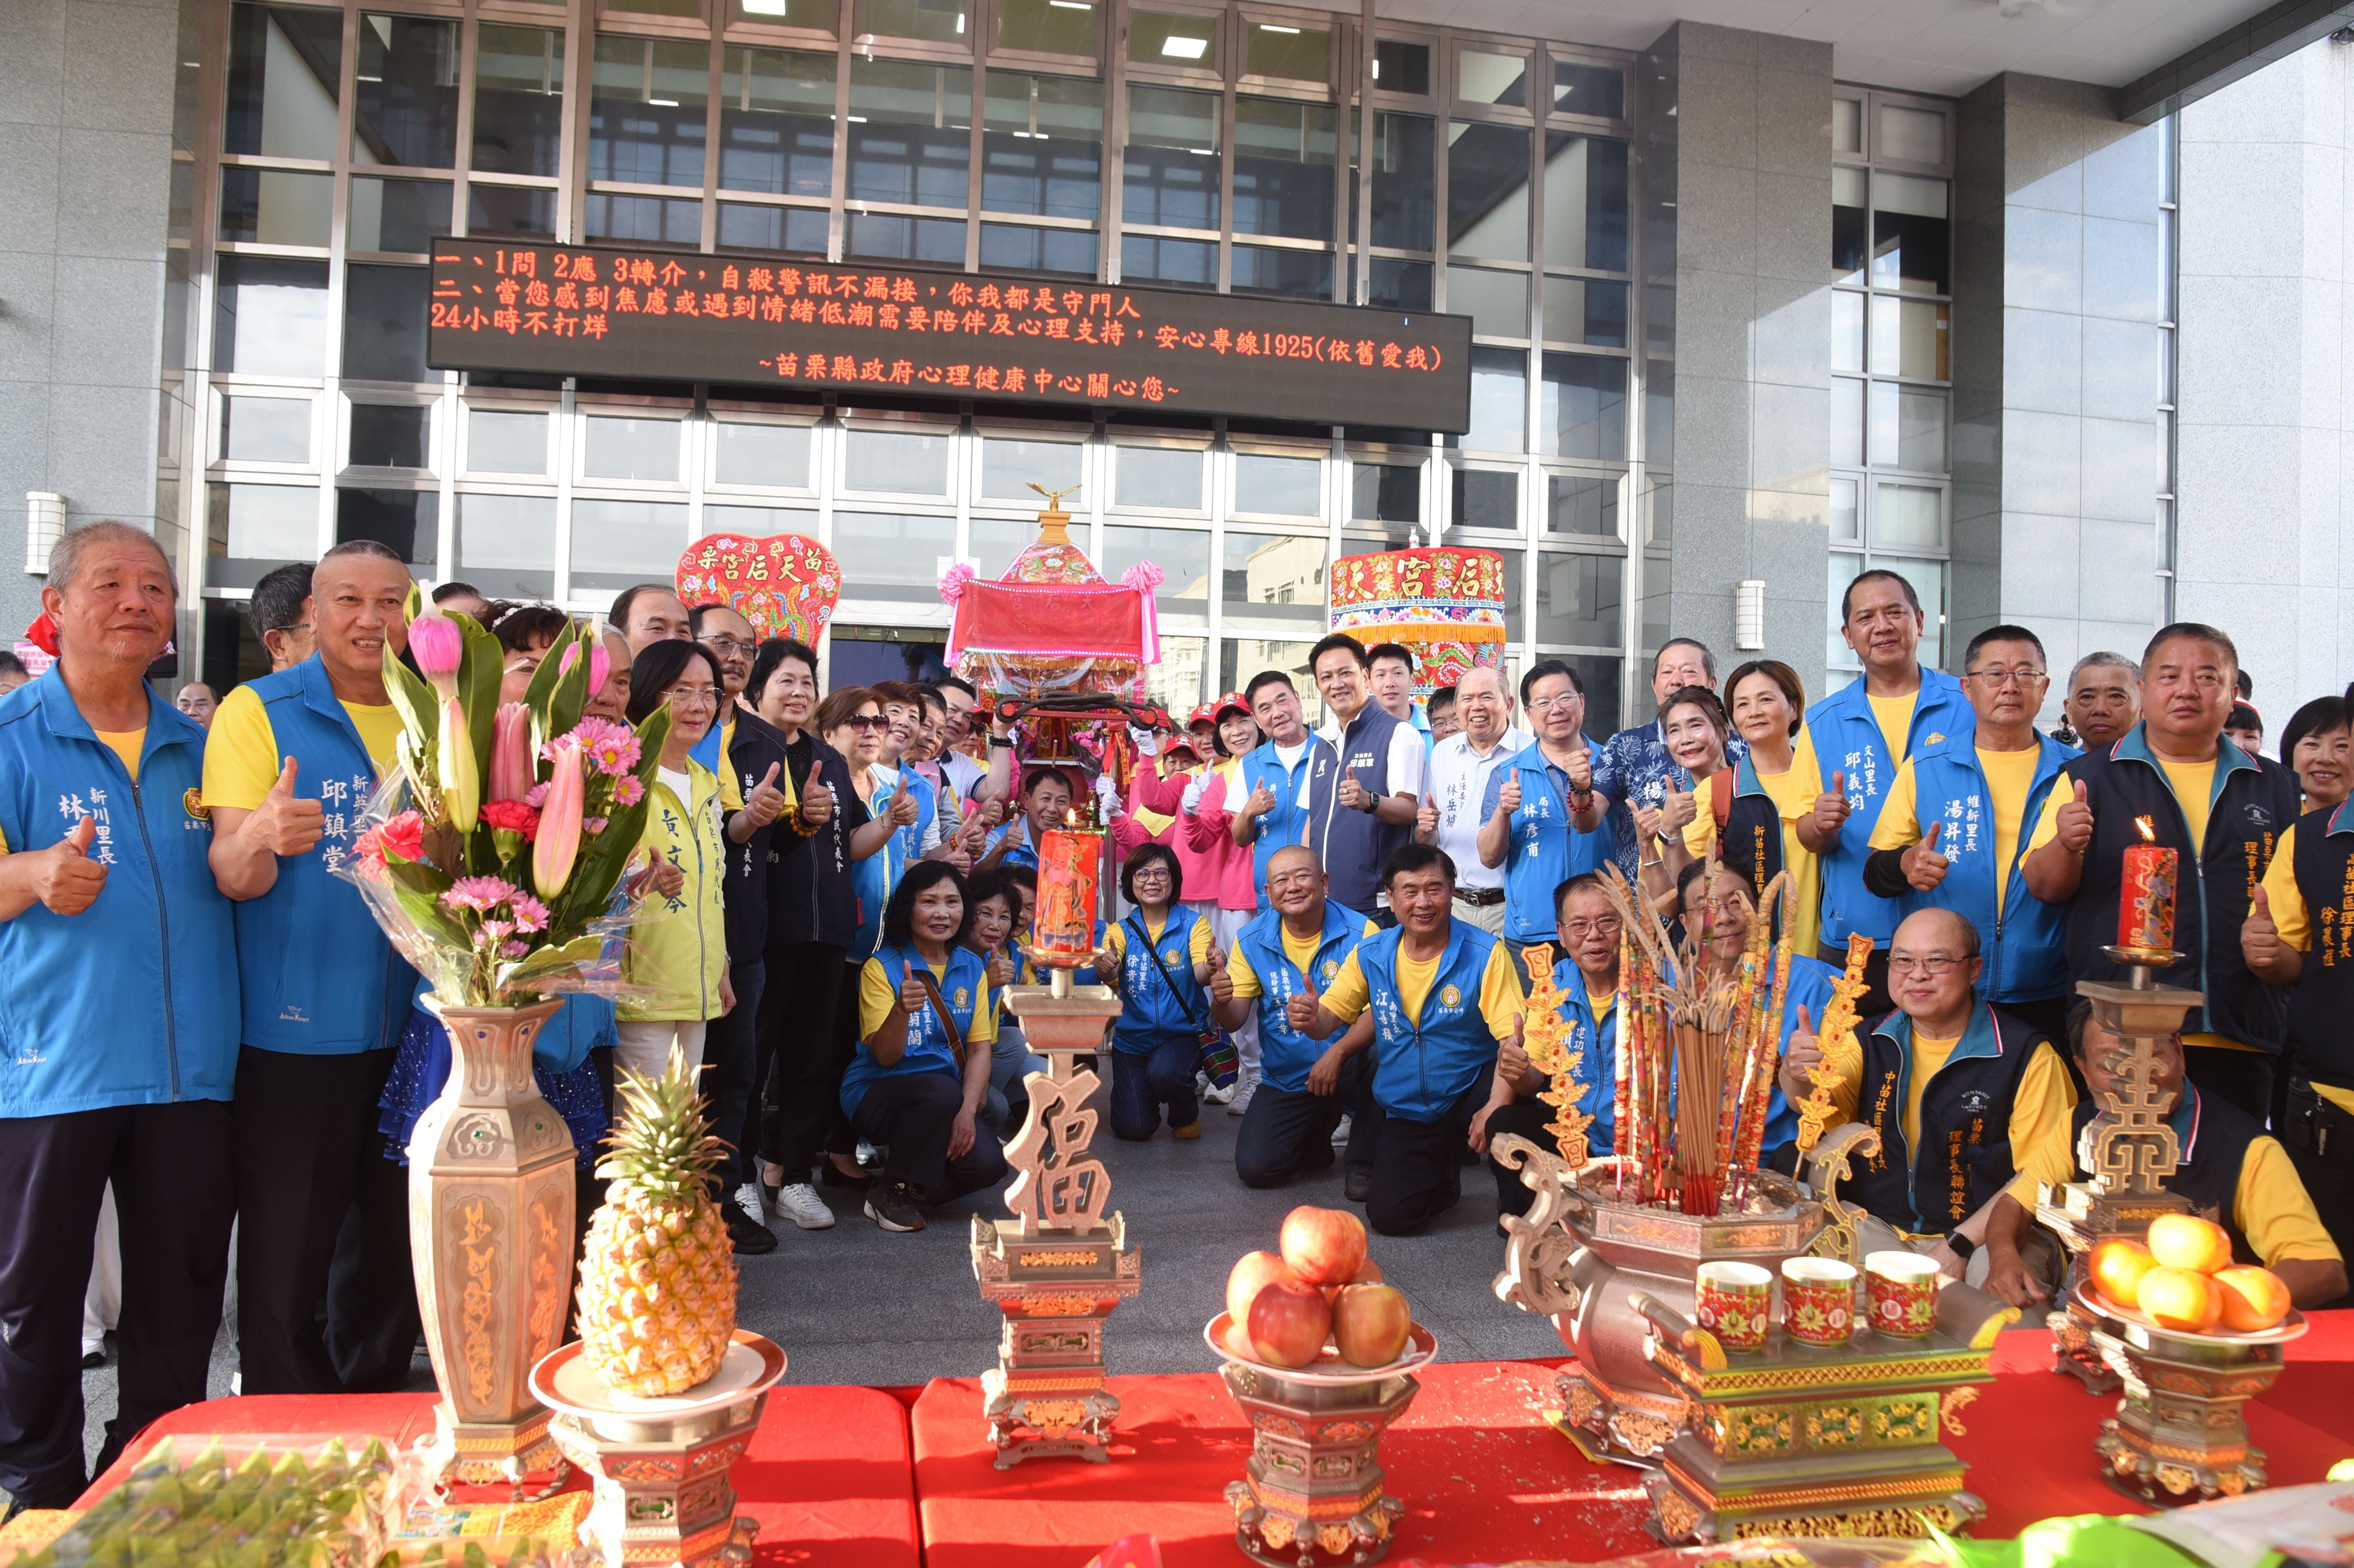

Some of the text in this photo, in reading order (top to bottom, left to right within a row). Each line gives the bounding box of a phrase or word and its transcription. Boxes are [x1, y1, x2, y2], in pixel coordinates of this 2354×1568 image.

[435, 249, 536, 278] 一、1問
[553, 253, 597, 282] 2應
[431, 303, 609, 341] 24小時不打烊
[1844, 751, 1864, 811] 邱義均
[1863, 745, 1878, 797] 文山里長
[89, 787, 118, 865] 新川里長
[183, 820, 213, 832] 苗栗市公
[321, 779, 349, 873] 邱鎮堂
[352, 774, 369, 845] 新英里
[743, 773, 755, 877] 苗栗表會
[1539, 796, 1550, 818] 局長
[1943, 800, 1964, 864] 湯昇發
[1964, 795, 1980, 852] 維新里長
[1138, 952, 1149, 991] 青苗里長
[1873, 1070, 1896, 1170] 中苗社區長
[1961, 1090, 1991, 1100] MONTAGUT
[1948, 1130, 1966, 1221] 理事長聯誼會
